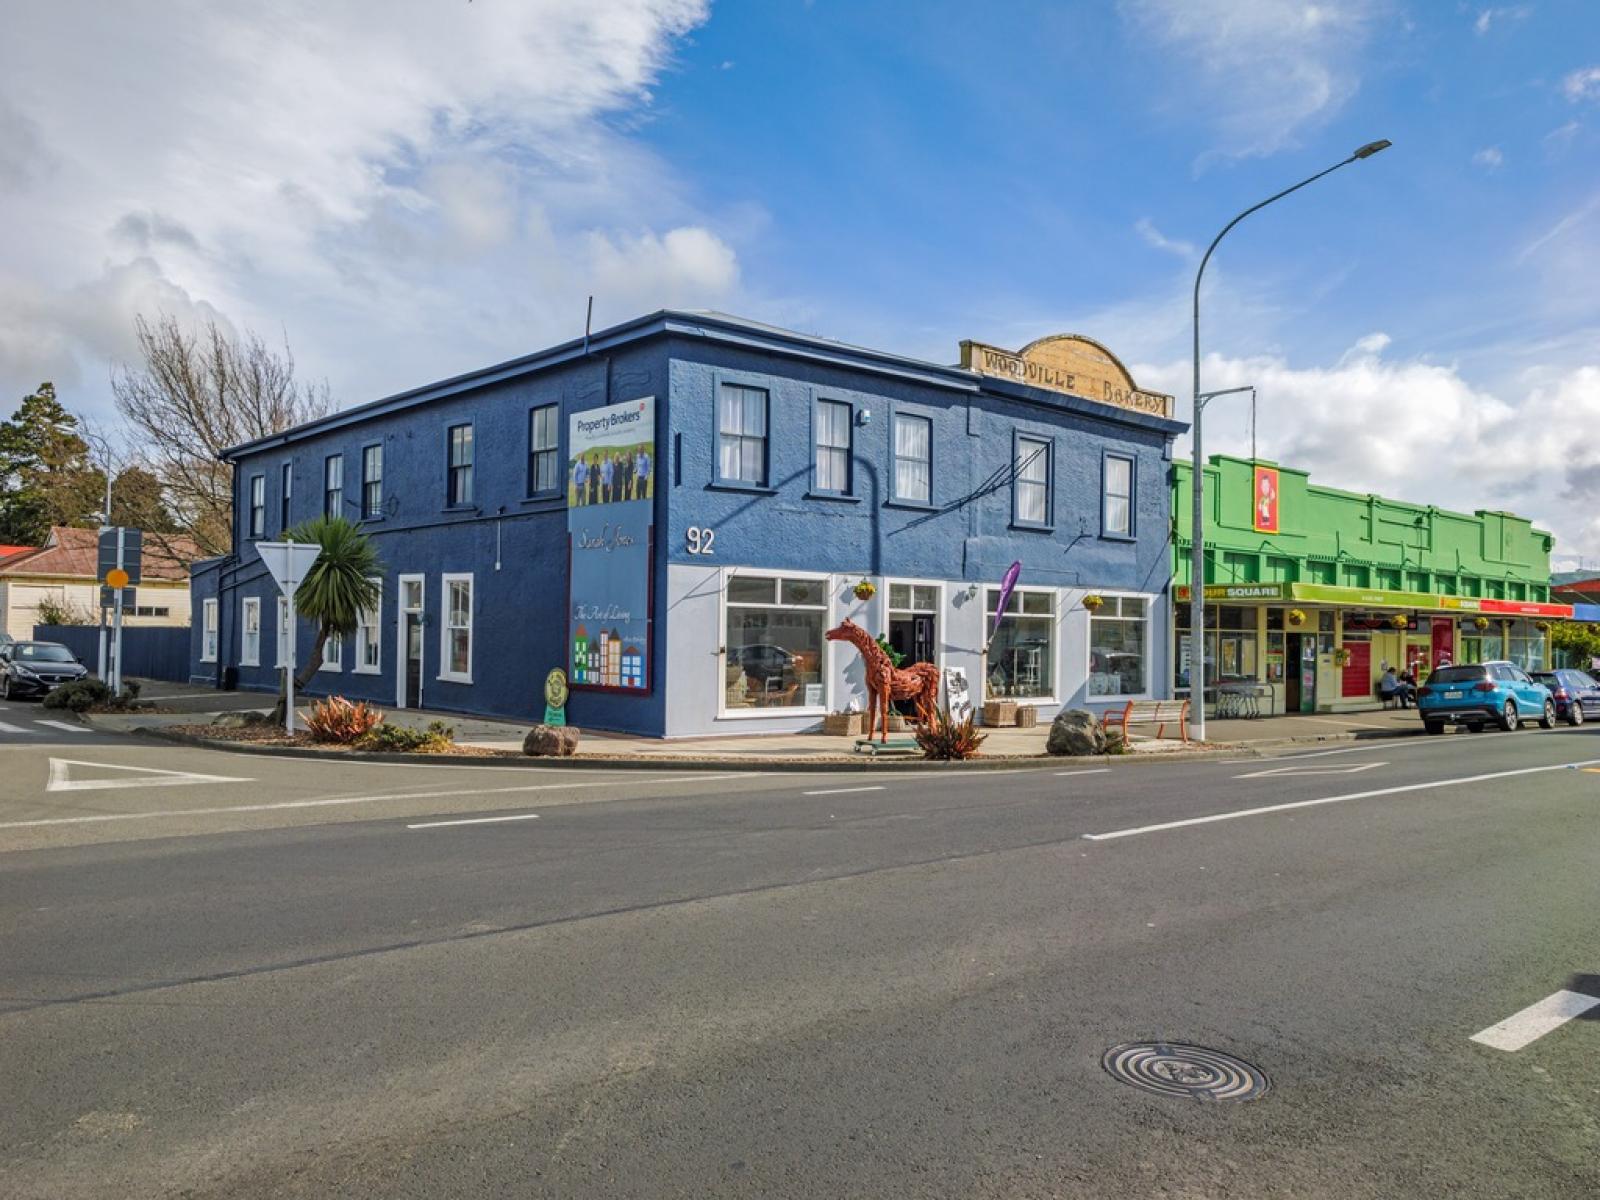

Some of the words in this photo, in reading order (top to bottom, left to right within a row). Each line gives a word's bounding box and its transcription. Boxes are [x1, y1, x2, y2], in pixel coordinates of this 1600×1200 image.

[985, 351, 1075, 389] WOODVILLE
[577, 416, 610, 433] Property
[610, 410, 640, 426] Brokers
[687, 526, 715, 554] 92
[1227, 587, 1279, 597] SQUARE
